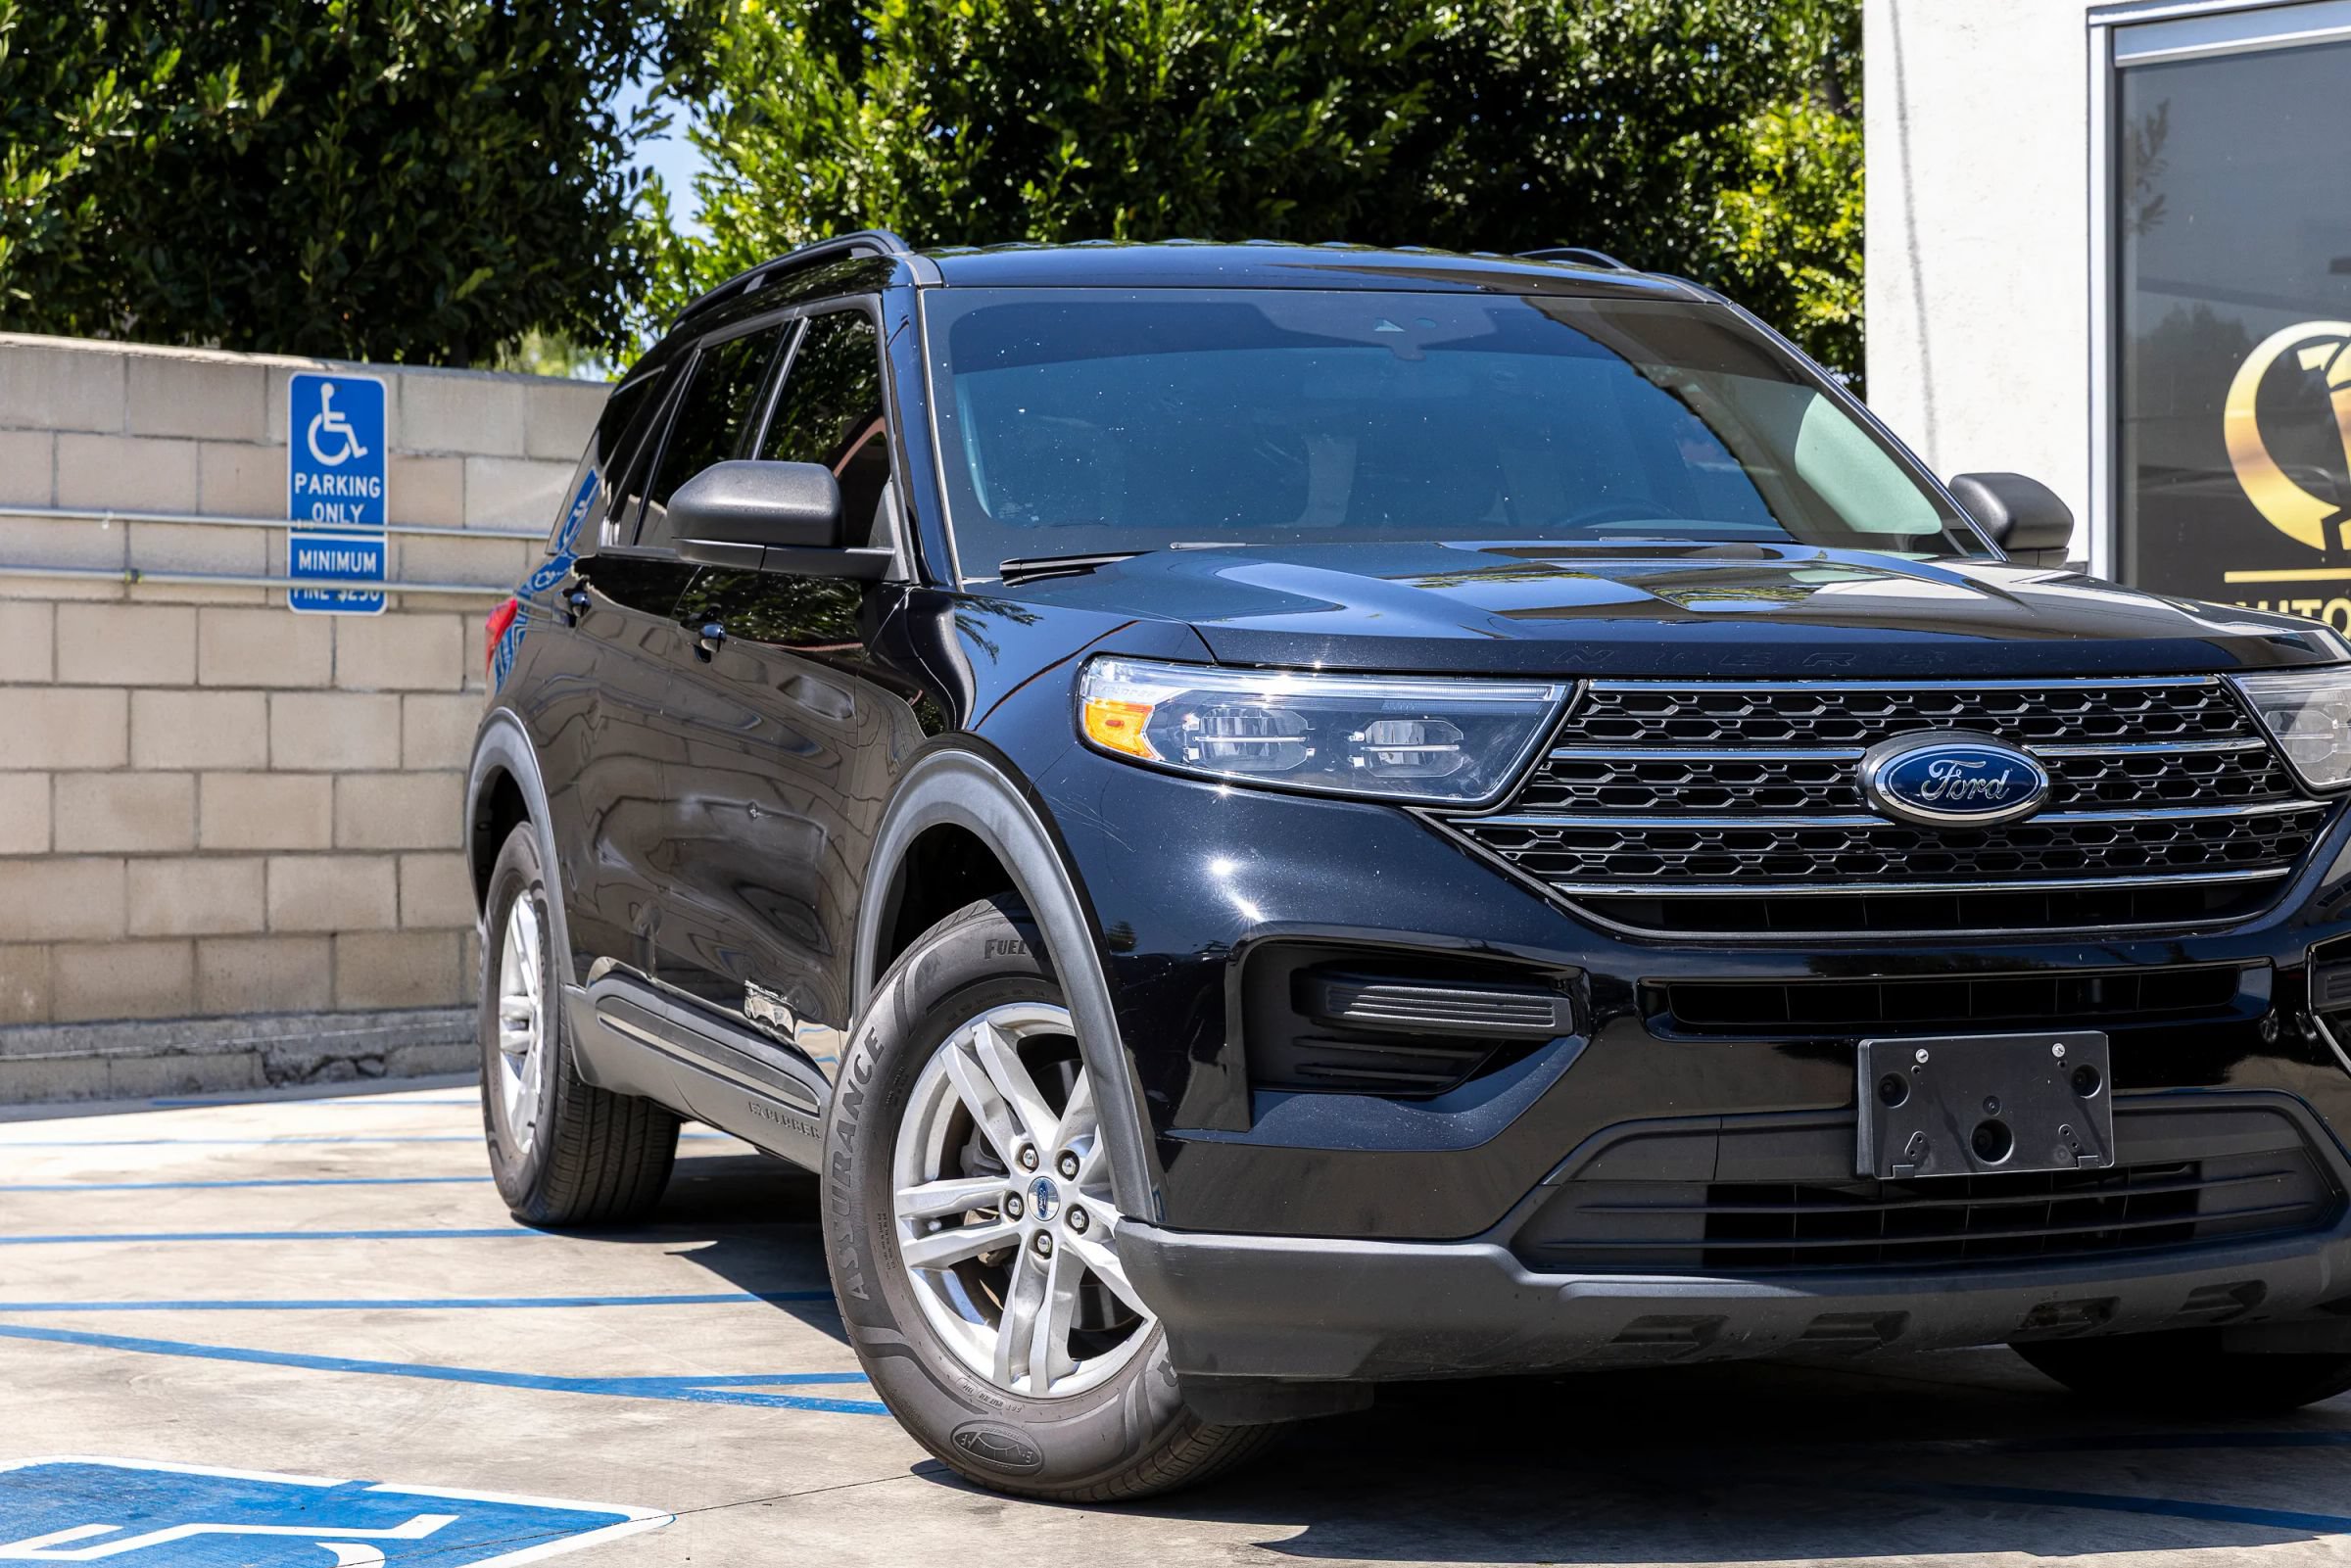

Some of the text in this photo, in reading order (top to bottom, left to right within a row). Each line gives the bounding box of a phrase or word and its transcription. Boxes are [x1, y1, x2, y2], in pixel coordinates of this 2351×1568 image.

[295, 472, 381, 499] PARKING
[312, 501, 365, 525] ONLY
[299, 548, 376, 573] MINIMUM
[1921, 759, 2010, 801] Ford
[984, 938, 1028, 960] FUEL
[833, 1026, 885, 1302] ASSURANCE
